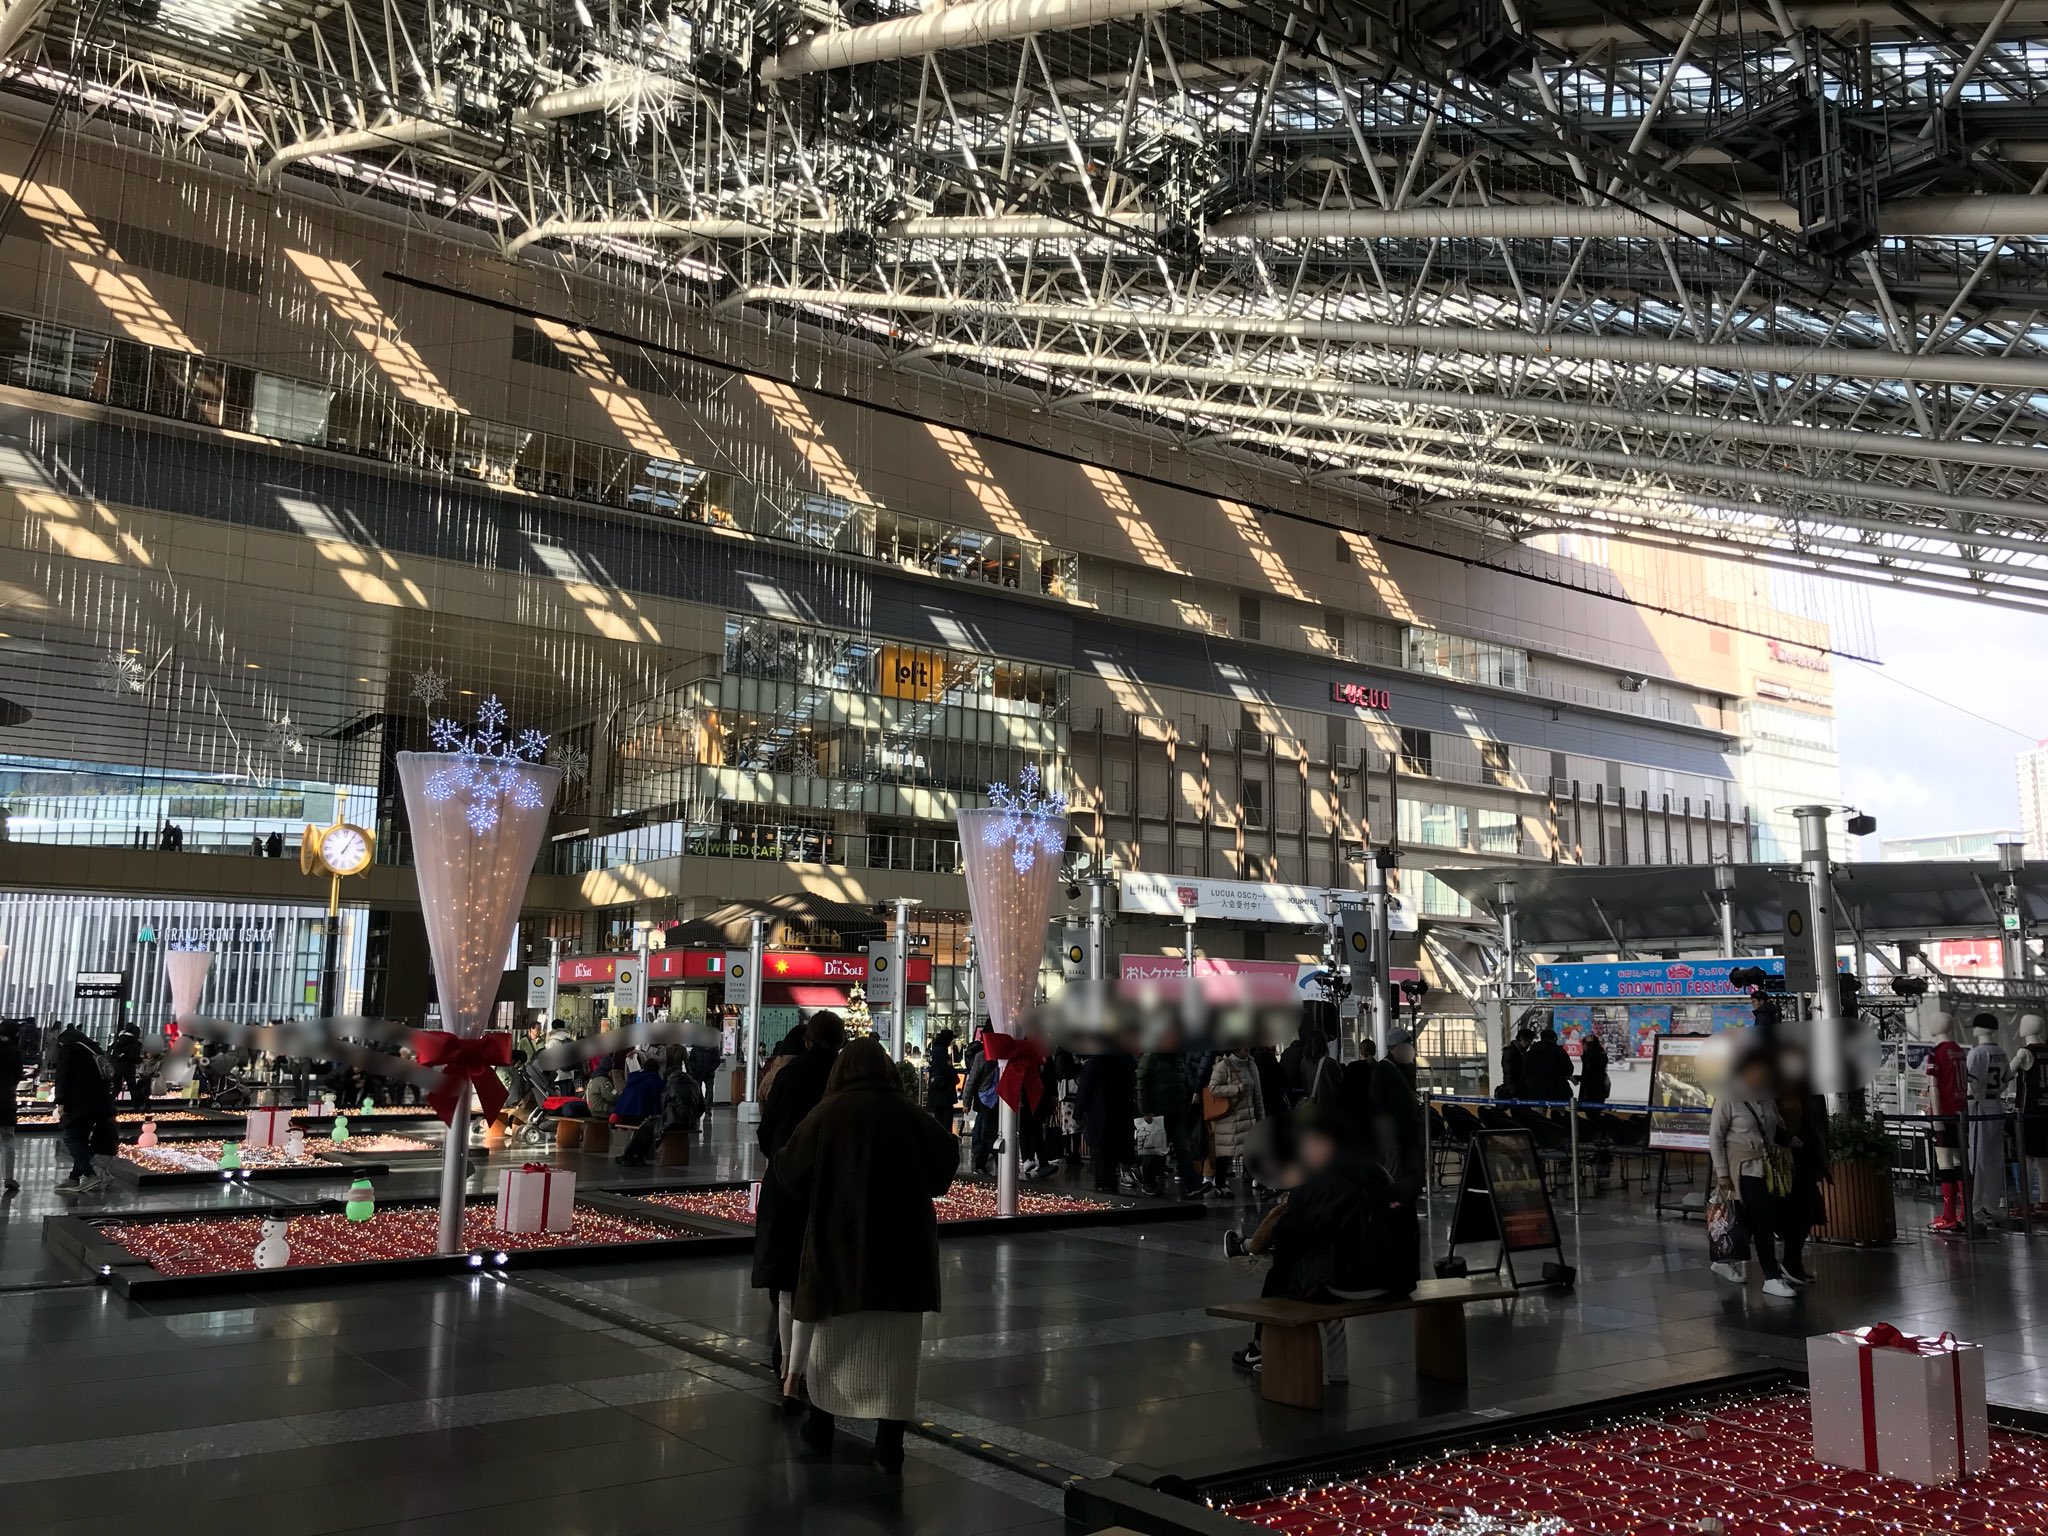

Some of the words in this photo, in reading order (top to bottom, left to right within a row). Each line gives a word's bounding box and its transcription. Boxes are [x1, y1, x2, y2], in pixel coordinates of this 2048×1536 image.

[709, 842, 749, 856] WIRED
[1211, 889, 1235, 898] LUCUA
[203, 928, 235, 942] FRONT
[238, 928, 274, 943] OSAKA
[1986, 1066, 2001, 1090] 3
